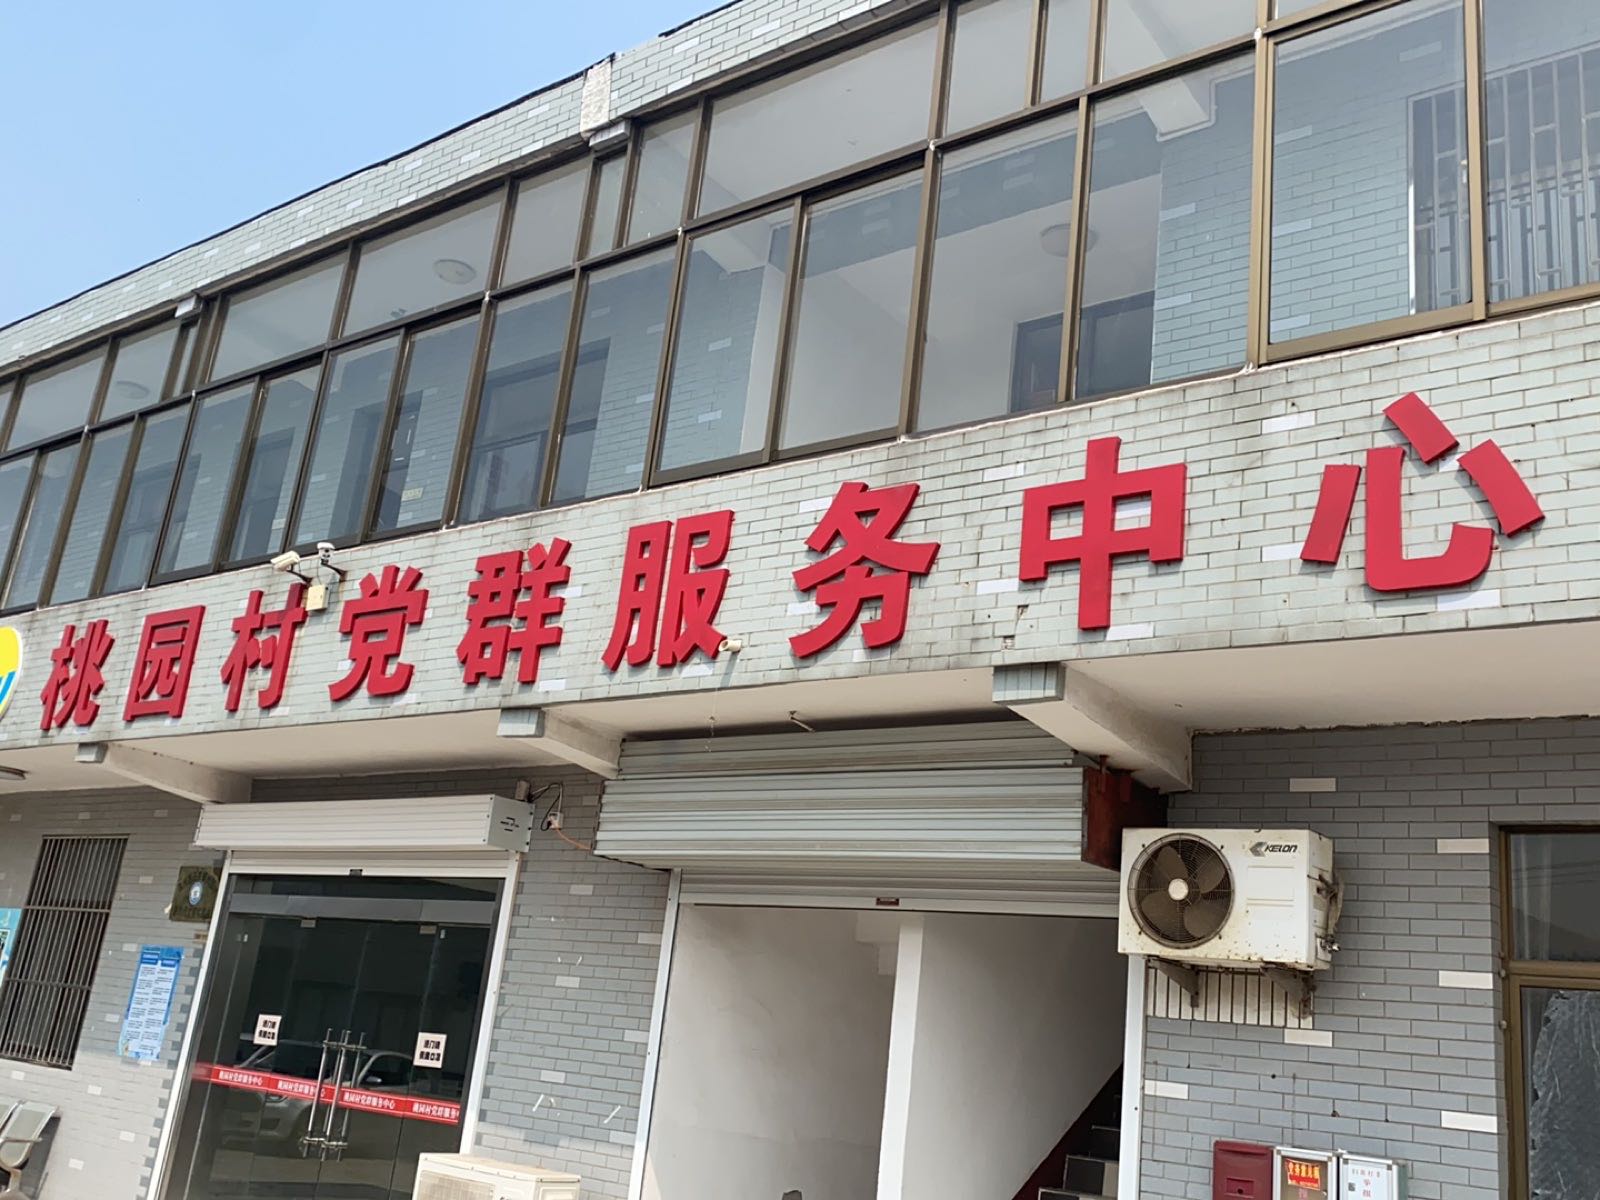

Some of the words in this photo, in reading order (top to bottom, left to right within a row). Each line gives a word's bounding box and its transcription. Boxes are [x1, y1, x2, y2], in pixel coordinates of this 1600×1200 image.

[40, 391, 1546, 732] 桃园村党群服务中心
[1264, 844, 1298, 853] KELON
